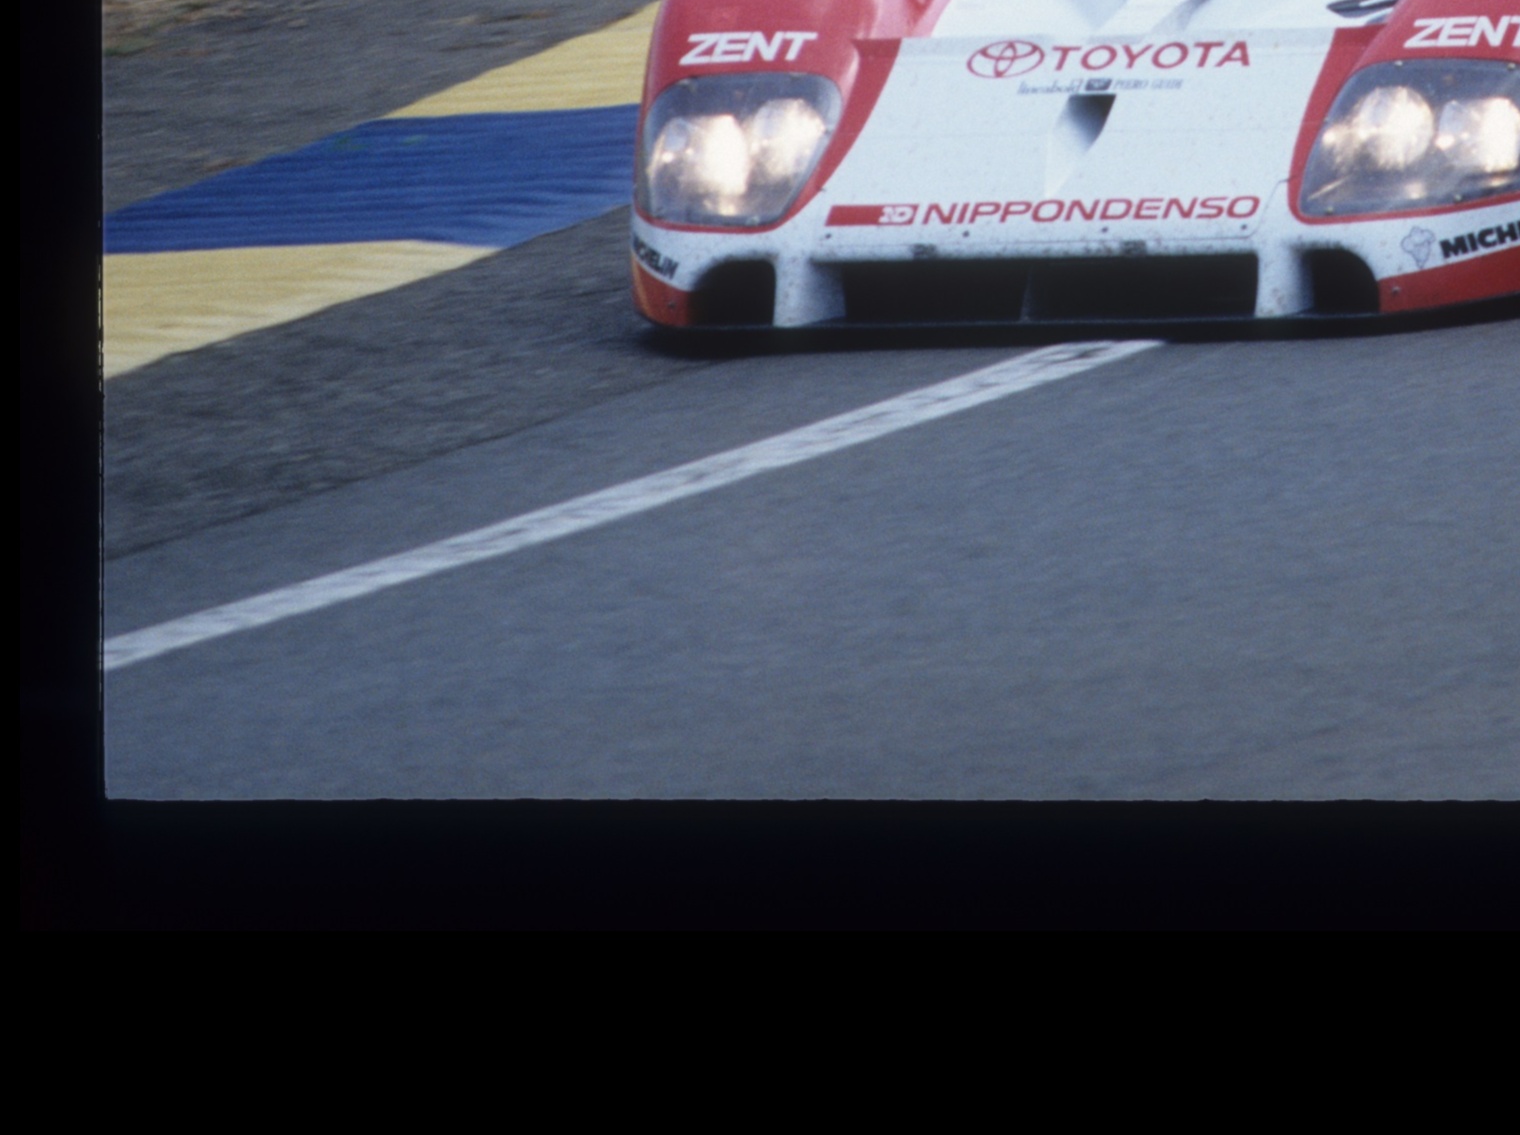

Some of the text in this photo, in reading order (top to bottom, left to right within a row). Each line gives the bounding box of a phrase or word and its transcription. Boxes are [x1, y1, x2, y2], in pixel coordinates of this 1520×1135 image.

[678, 31, 818, 66] ZENT
[1052, 41, 1250, 71] TOYOTA
[921, 195, 1261, 225] NIPPONDENSO
